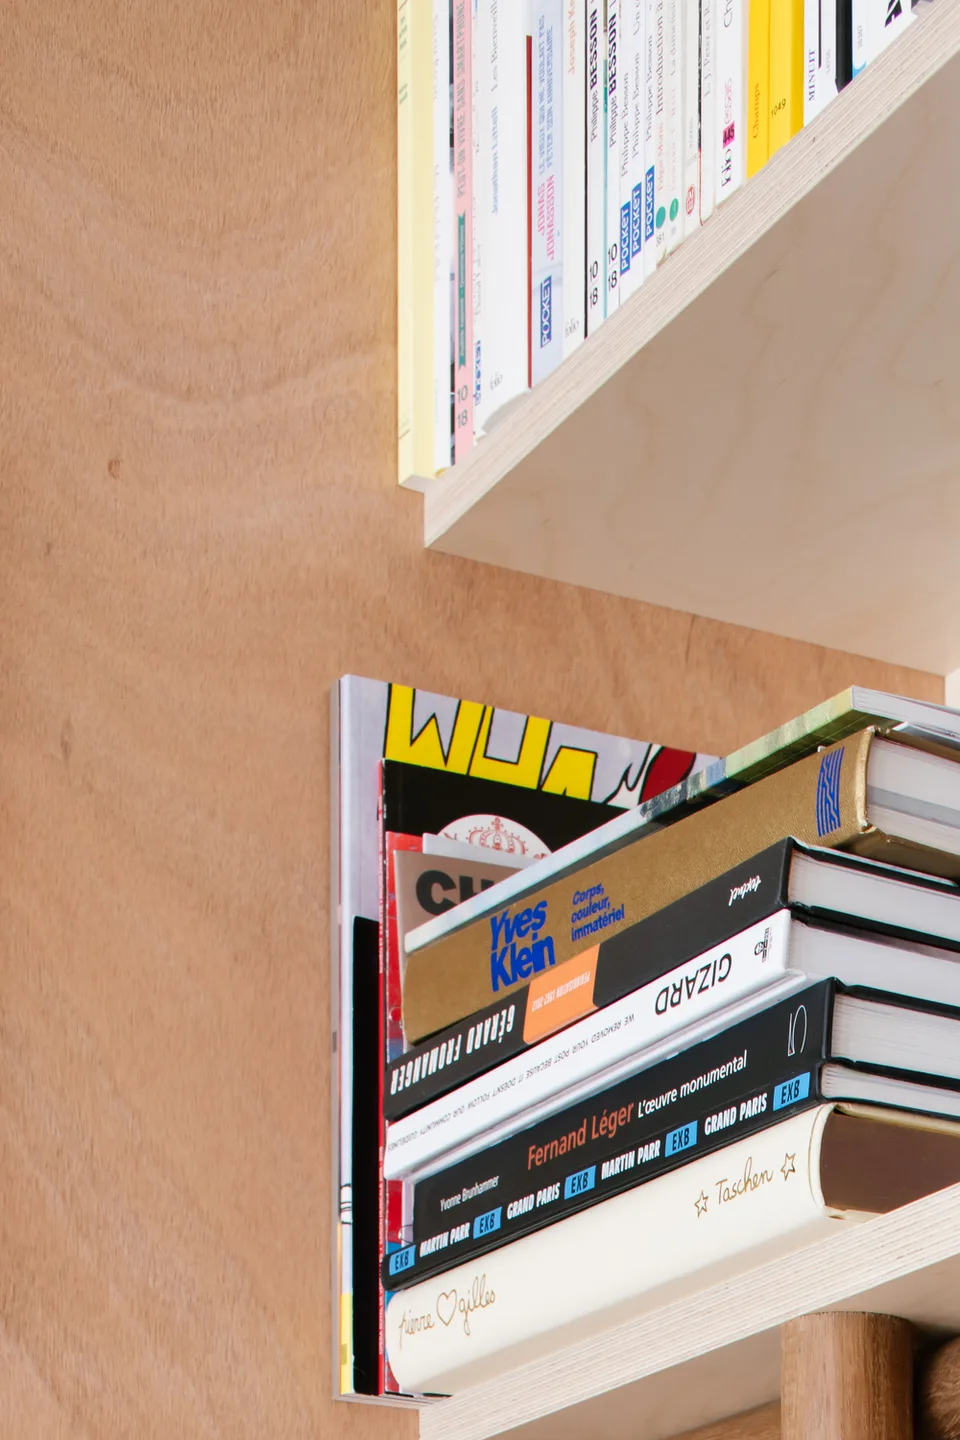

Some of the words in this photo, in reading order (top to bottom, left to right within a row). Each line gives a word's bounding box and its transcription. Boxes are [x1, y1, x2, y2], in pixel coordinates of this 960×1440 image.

[589, 8, 598, 92] BESSON
[608, 13, 617, 96] BESSON
[590, 89, 599, 143] Philippe
[608, 96, 618, 148] Philippe
[724, 77, 733, 125] essais
[752, 82, 761, 139] Champs
[621, 121, 630, 178] Philippe
[632, 101, 640, 159] Philippe
[632, 188, 641, 252] POCKET
[645, 173, 653, 236] POCKET
[608, 243, 618, 264] 10
[621, 207, 629, 272] POCKET
[590, 261, 598, 282] 10
[608, 270, 618, 292] 18
[542, 275, 552, 347] POCKET
[590, 287, 598, 309] 18
[570, 895, 612, 924] couleur,
[571, 882, 605, 907] Corps,
[727, 874, 763, 908] textuel
[489, 899, 549, 947] Yves
[570, 903, 626, 943] immatériel
[489, 932, 557, 993] Klein
[654, 952, 734, 1016] GIZARD
[465, 1003, 517, 1056] GÉRARD
[590, 1019, 622, 1045] REMOVED
[624, 1012, 636, 1026] WE
[389, 1032, 463, 1096] FROMANGER
[525, 1056, 553, 1080] BECAUSE
[553, 1048, 571, 1065] POST
[571, 1038, 590, 1055] YOUR
[467, 1091, 492, 1111] FOLLOW
[517, 1073, 526, 1085] IT
[419, 1112, 452, 1136] COMMUNITY
[452, 1104, 466, 1119] OUR
[526, 1116, 588, 1171] Fernand
[590, 1101, 634, 1141] Léger
[637, 1087, 679, 1120] L'œuvre
[679, 1048, 749, 1100] monumental
[394, 1248, 411, 1272] EXB
[419, 1231, 450, 1259] MARTIN
[449, 1221, 472, 1246] PARR
[478, 1212, 497, 1236] EXB
[506, 1195, 535, 1220] GRAND
[535, 1181, 562, 1208] PARIS
[570, 1171, 590, 1195] EXB
[601, 1149, 637, 1181] MARTIN
[636, 1139, 662, 1168] PARR
[671, 1126, 691, 1152] EXB
[703, 1104, 738, 1136] GRAND
[739, 1091, 769, 1122] PARIS
[780, 1078, 801, 1106] EXB
[439, 1192, 462, 1213] Yvonne
[462, 1174, 500, 1204] Brunhammer
[714, 1154, 775, 1204] Taschen
[397, 1306, 436, 1351] pierre
[456, 1272, 497, 1338] gilles
